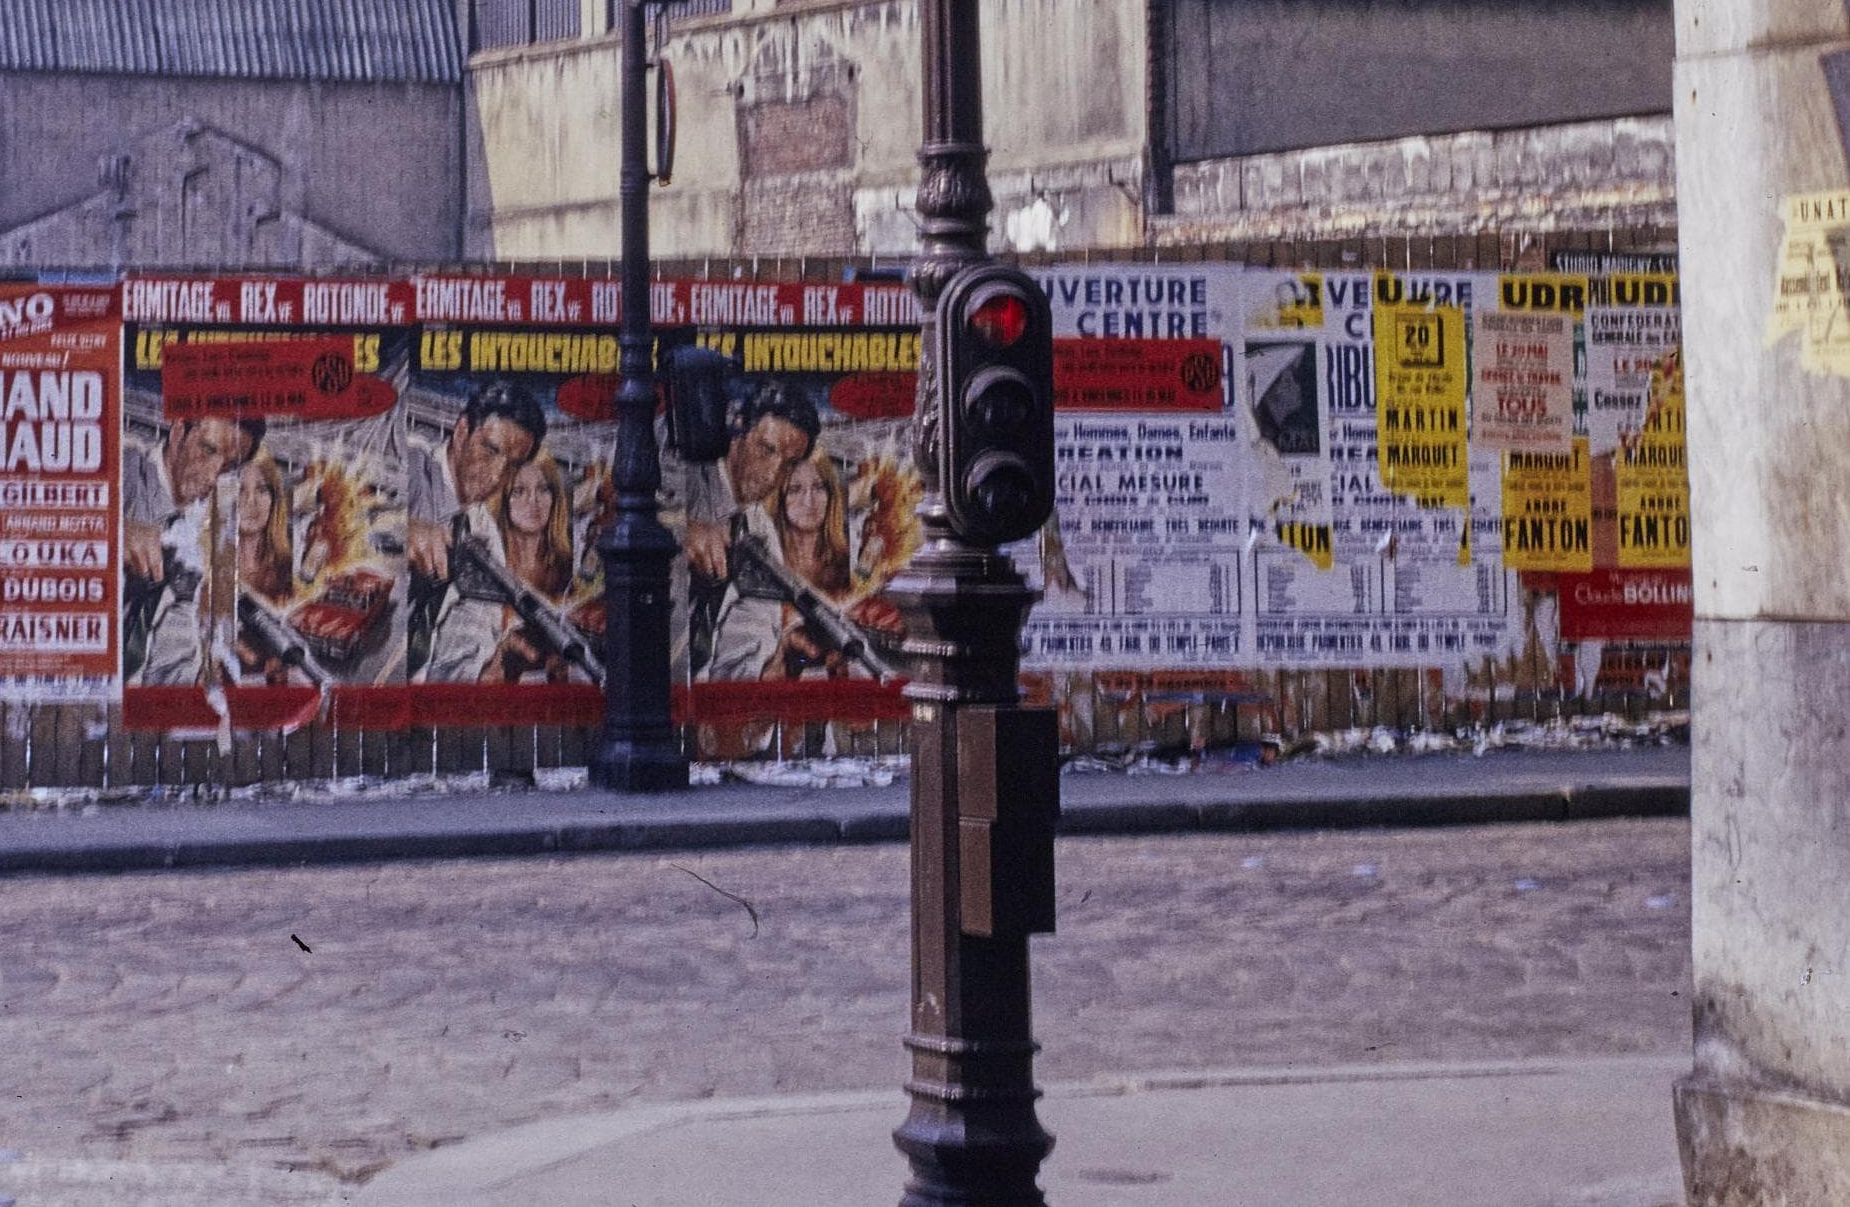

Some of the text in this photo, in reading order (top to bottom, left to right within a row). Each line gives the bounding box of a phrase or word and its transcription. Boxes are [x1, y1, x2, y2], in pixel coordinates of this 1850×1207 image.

[122, 280, 214, 322] ERMITAGE
[240, 282, 277, 323] REX
[303, 283, 390, 324] ROTONDE
[415, 279, 506, 321] ERMITAGE
[531, 281, 566, 322] REX
[691, 284, 779, 325] ERMITAGE
[804, 286, 838, 325] REX
[1502, 281, 1585, 310] UDR
[1615, 279, 1679, 305] UD
[1077, 311, 1207, 339] CENTRE
[1405, 325, 1429, 347] 20
[421, 330, 463, 371] LES
[1386, 408, 1457, 433] MARTIN
[1387, 445, 1458, 469] MARQUET
[3, 482, 103, 505] GILBERT
[1118, 475, 1204, 491] MESURE
[1505, 517, 1589, 551] FANTON
[3, 577, 104, 603] DUBOIS
[1624, 582, 1693, 605] BOLLIN
